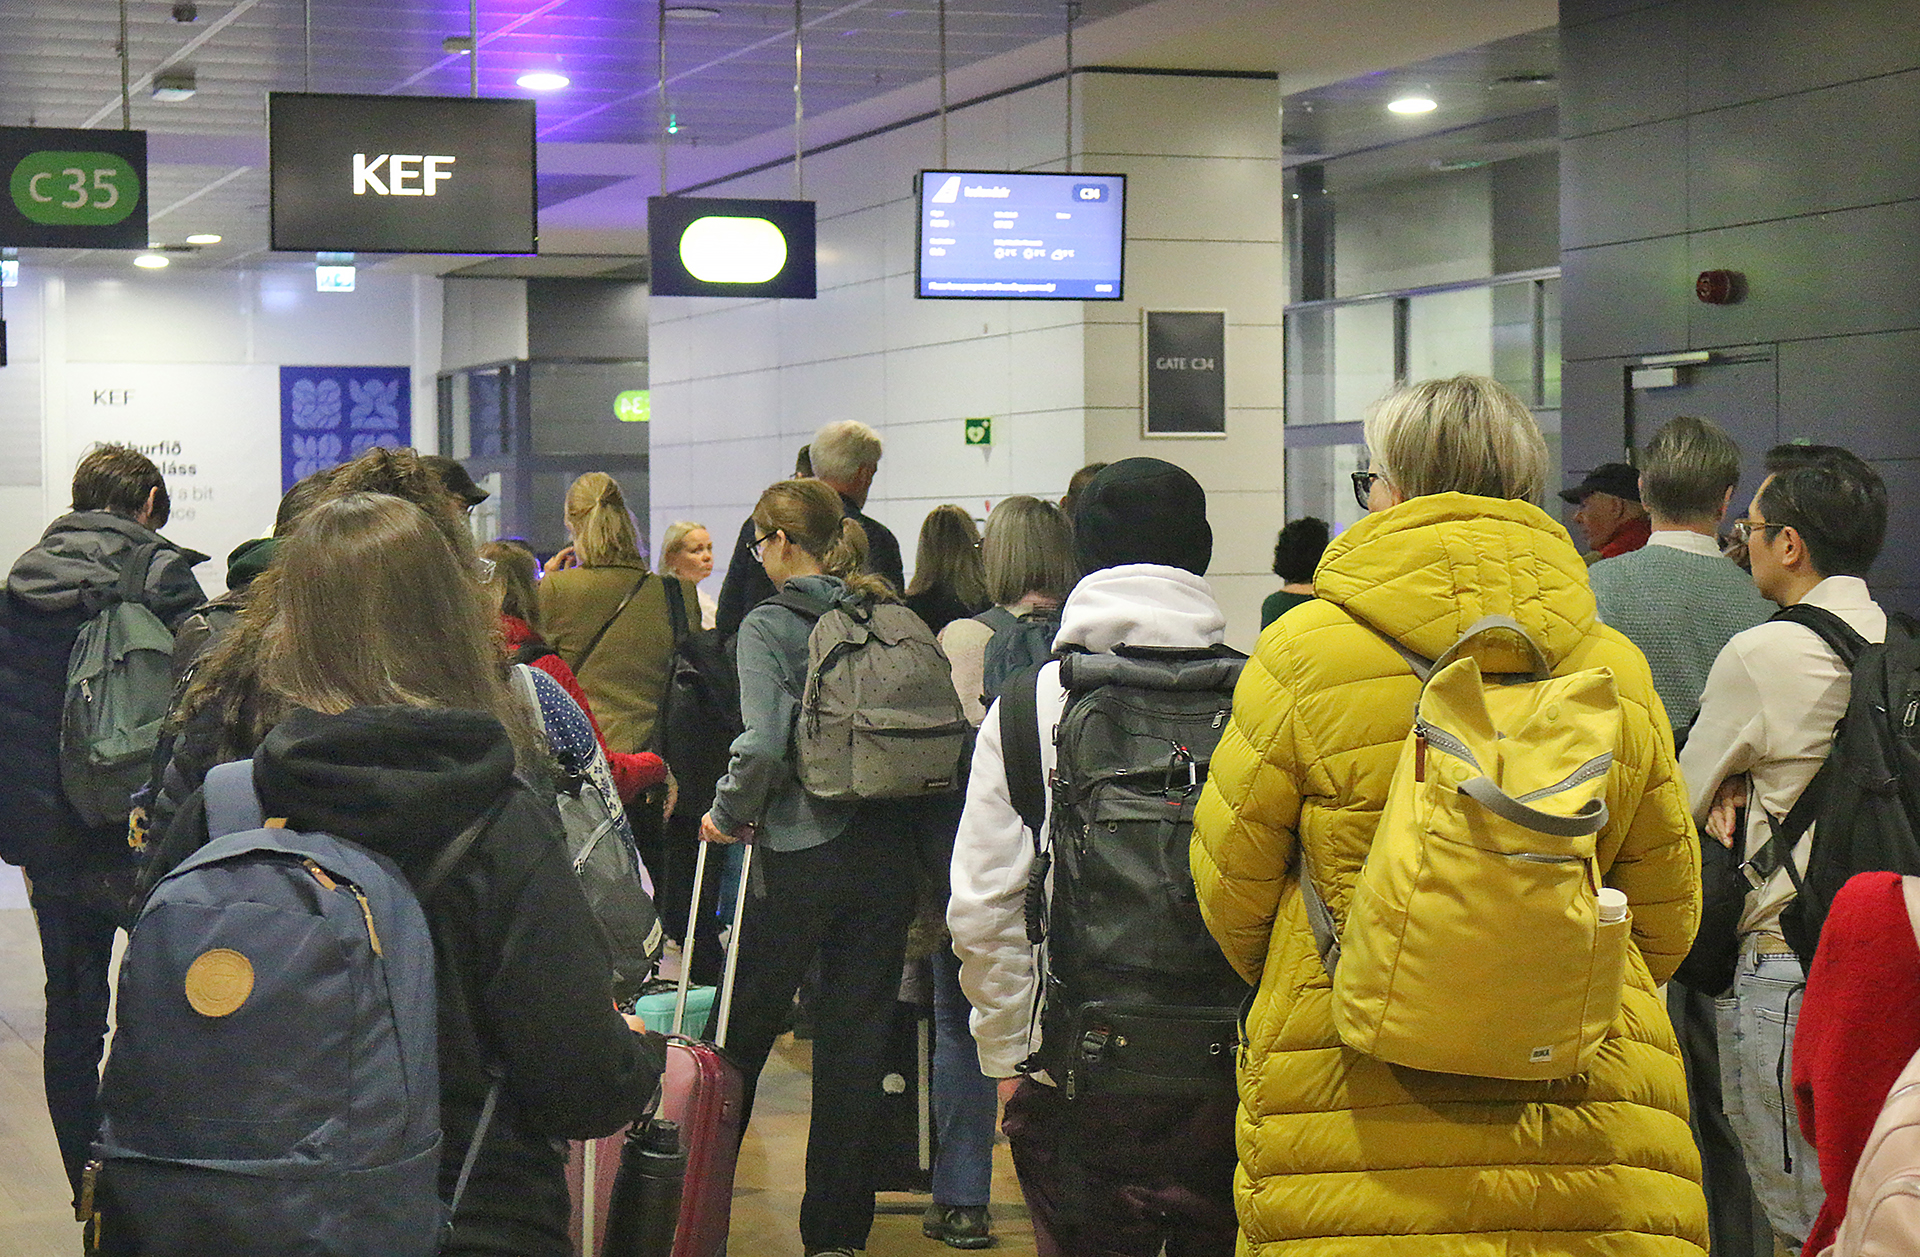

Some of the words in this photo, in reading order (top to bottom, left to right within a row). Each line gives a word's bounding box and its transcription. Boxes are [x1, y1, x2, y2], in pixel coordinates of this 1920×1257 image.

[353, 153, 456, 197] KEF
[1156, 357, 1187, 370] GATE
[94, 389, 135, 406] KEF
[157, 461, 197, 476] láss
[192, 485, 214, 501] bit
